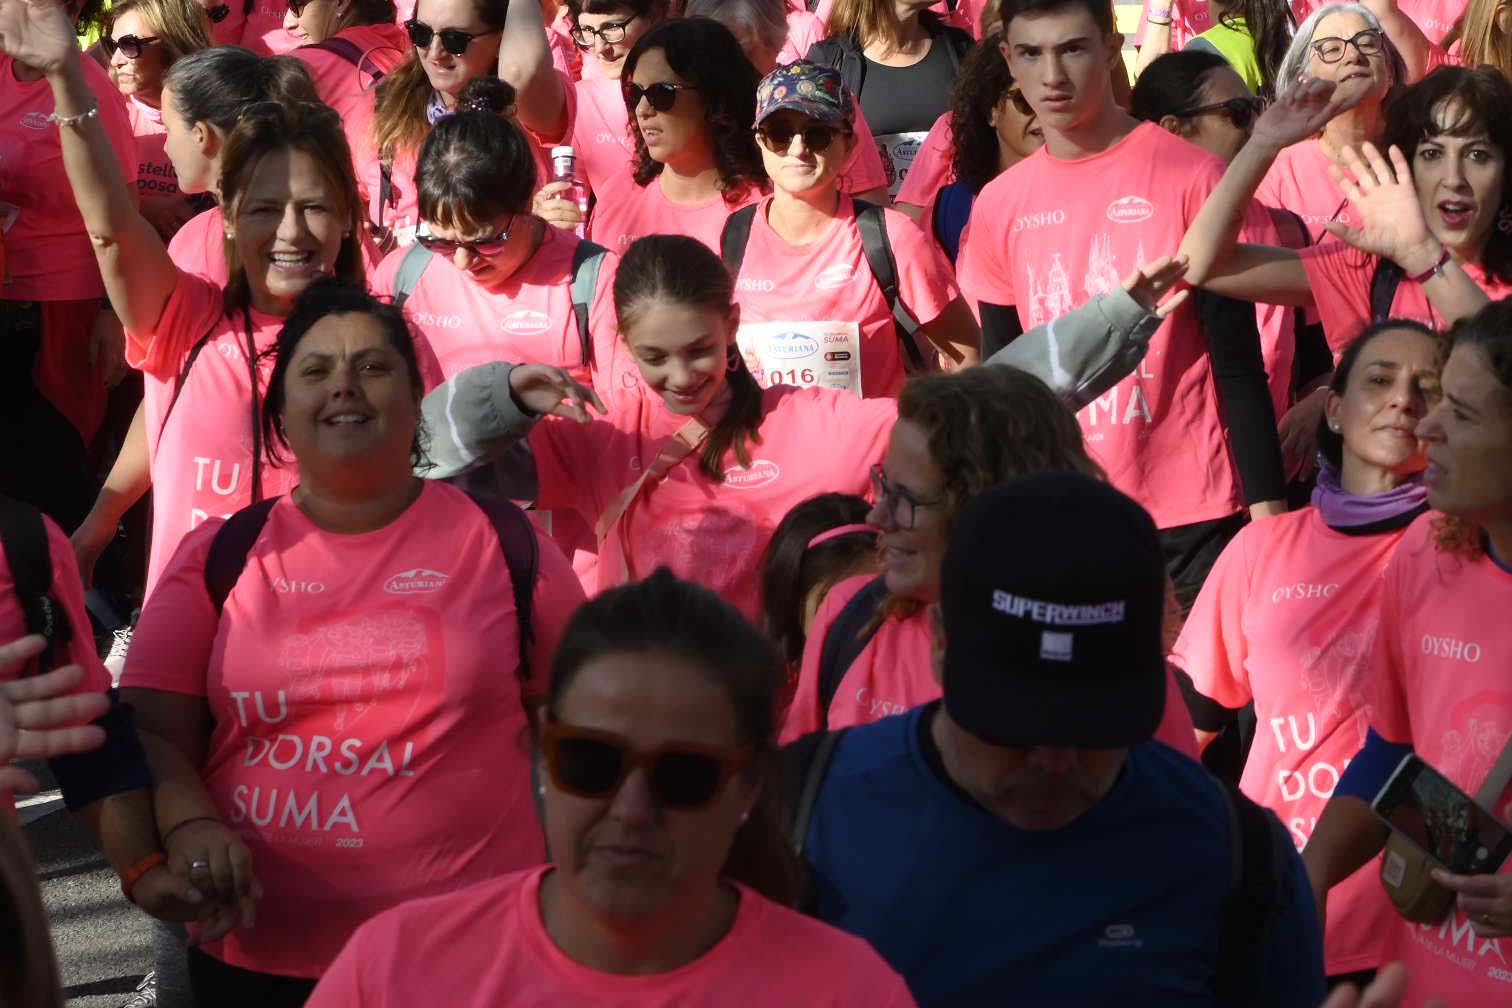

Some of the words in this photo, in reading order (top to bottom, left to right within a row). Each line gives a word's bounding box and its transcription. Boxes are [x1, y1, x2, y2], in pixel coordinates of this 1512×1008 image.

[1013, 209, 1065, 232] OYSHO
[412, 310, 462, 329] OYSHO
[823, 335, 849, 344] SUMA
[770, 368, 815, 386] 016
[193, 456, 241, 497] TU
[992, 589, 1126, 625] SUPERWINCH
[1421, 634, 1481, 663] OYSHO
[231, 690, 288, 727] TU
[1270, 714, 1318, 752] TU
[243, 734, 416, 776] DORSAL
[231, 784, 360, 833] SUMA
